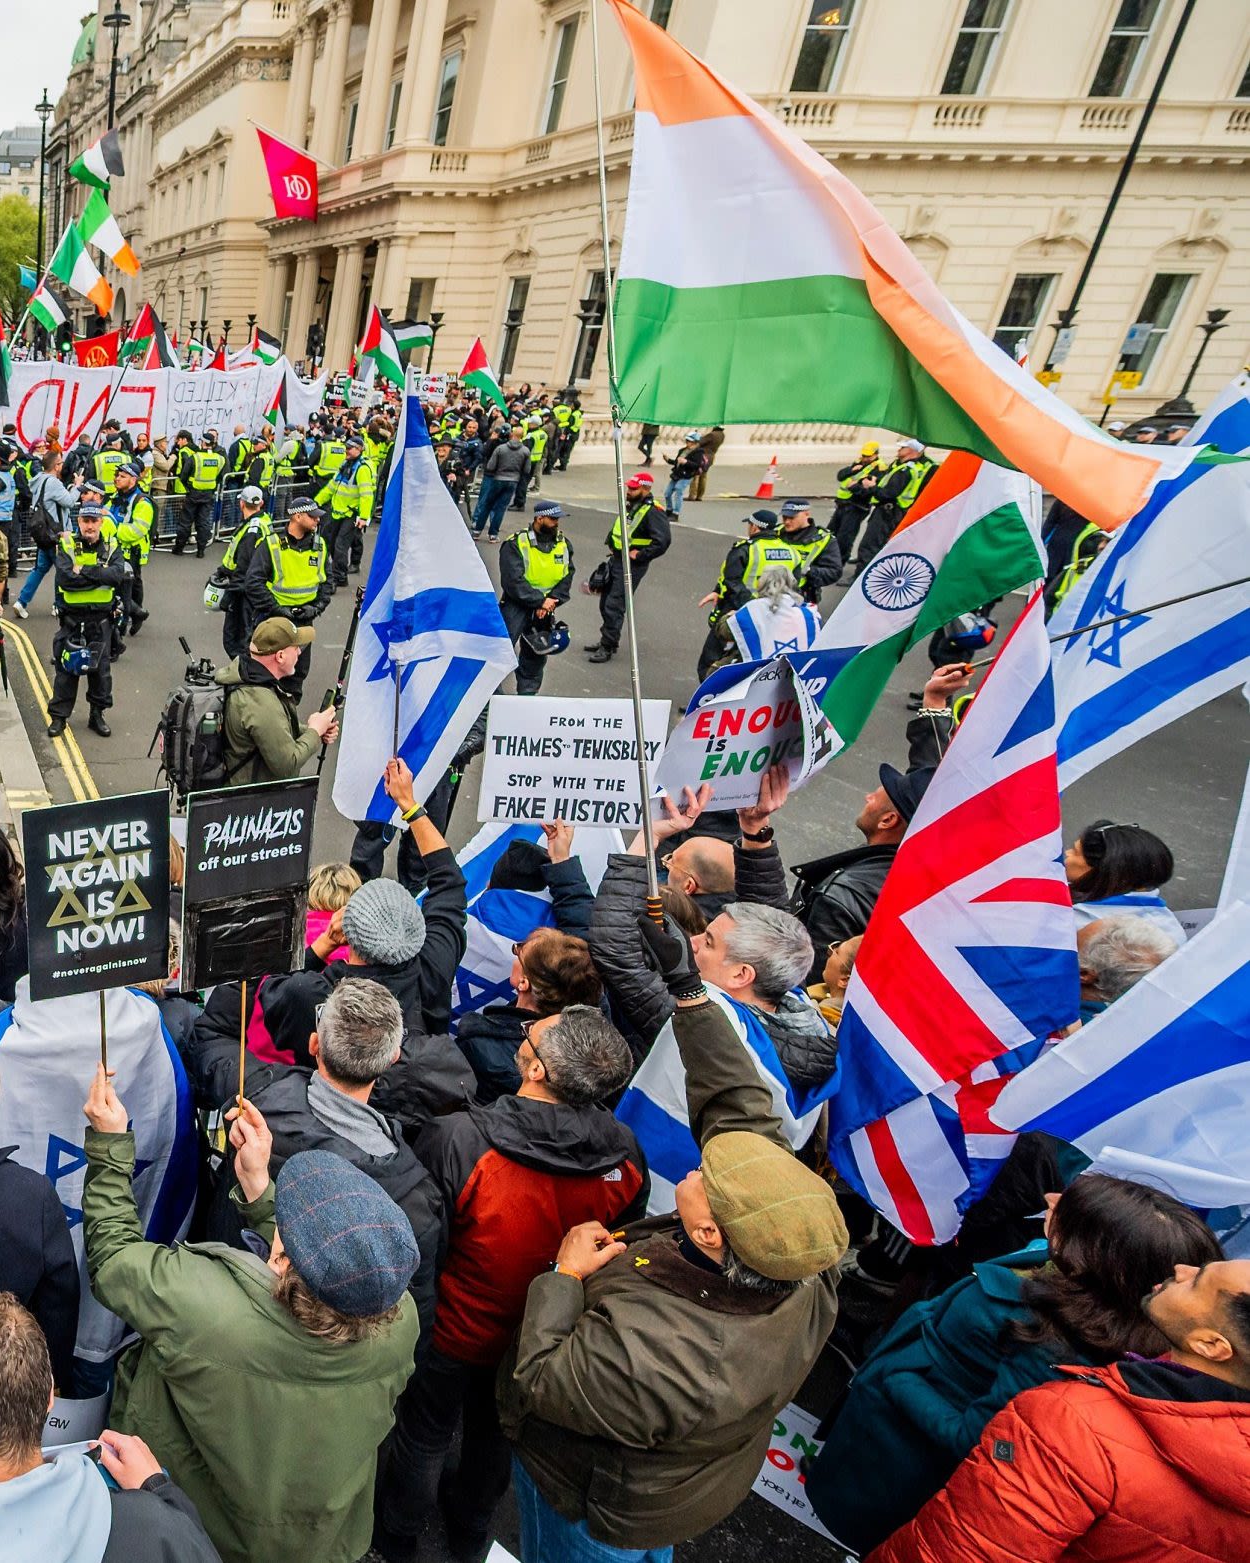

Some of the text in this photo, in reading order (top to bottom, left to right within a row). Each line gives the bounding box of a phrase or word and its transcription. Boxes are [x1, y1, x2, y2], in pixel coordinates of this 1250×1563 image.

[549, 716, 623, 729] FROM THE
[492, 735, 562, 758] THAMES
[706, 734, 727, 753] is
[507, 774, 626, 792] STOP WITH THE
[492, 796, 645, 824] FAKE HISTORY
[48, 820, 150, 858] NEVER
[203, 806, 304, 852] PALINAZIS
[198, 842, 303, 872] off our streets
[48, 853, 150, 892] AGAIN
[88, 891, 115, 918] IS
[57, 916, 145, 954] NOW!
[52, 956, 148, 979] #neveragainisnow
